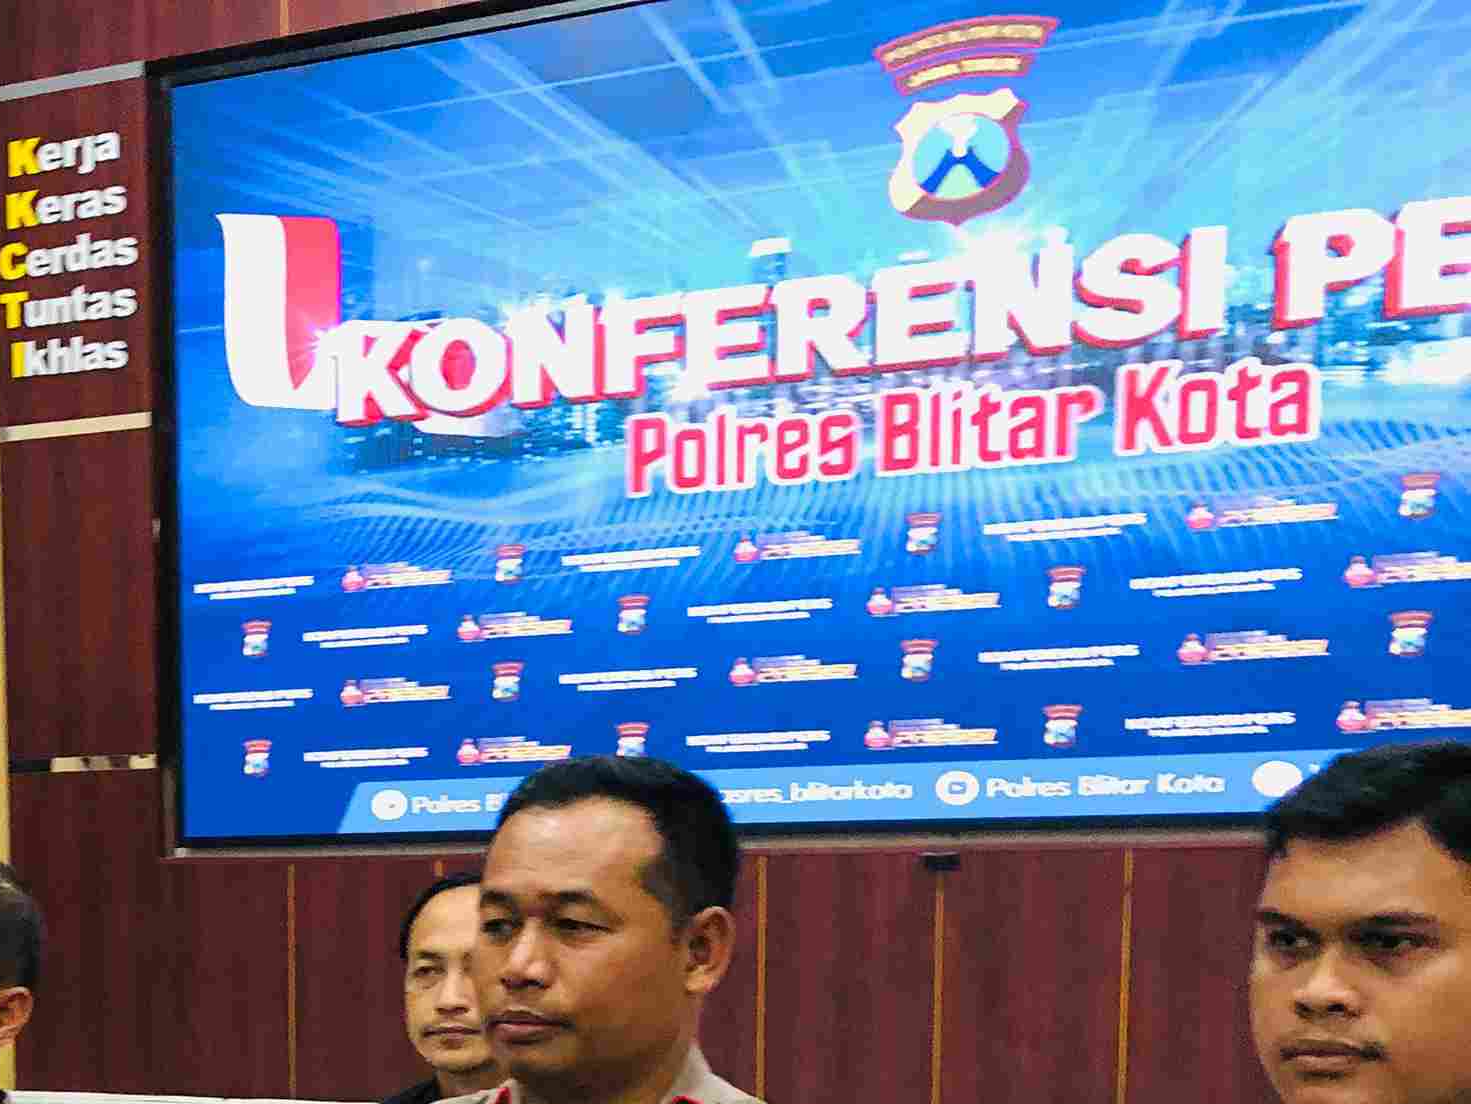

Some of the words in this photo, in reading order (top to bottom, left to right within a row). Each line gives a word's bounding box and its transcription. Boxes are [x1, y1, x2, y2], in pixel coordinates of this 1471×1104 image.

[8, 131, 120, 178] Kerja
[5, 181, 128, 232] Keras
[0, 284, 138, 330] Tuntas
[328, 226, 1228, 430] KONFERENSI
[10, 336, 129, 379] Ikhlas
[627, 405, 862, 500] Polres
[877, 378, 1104, 478] Blitar
[1116, 357, 1322, 458] Kota
